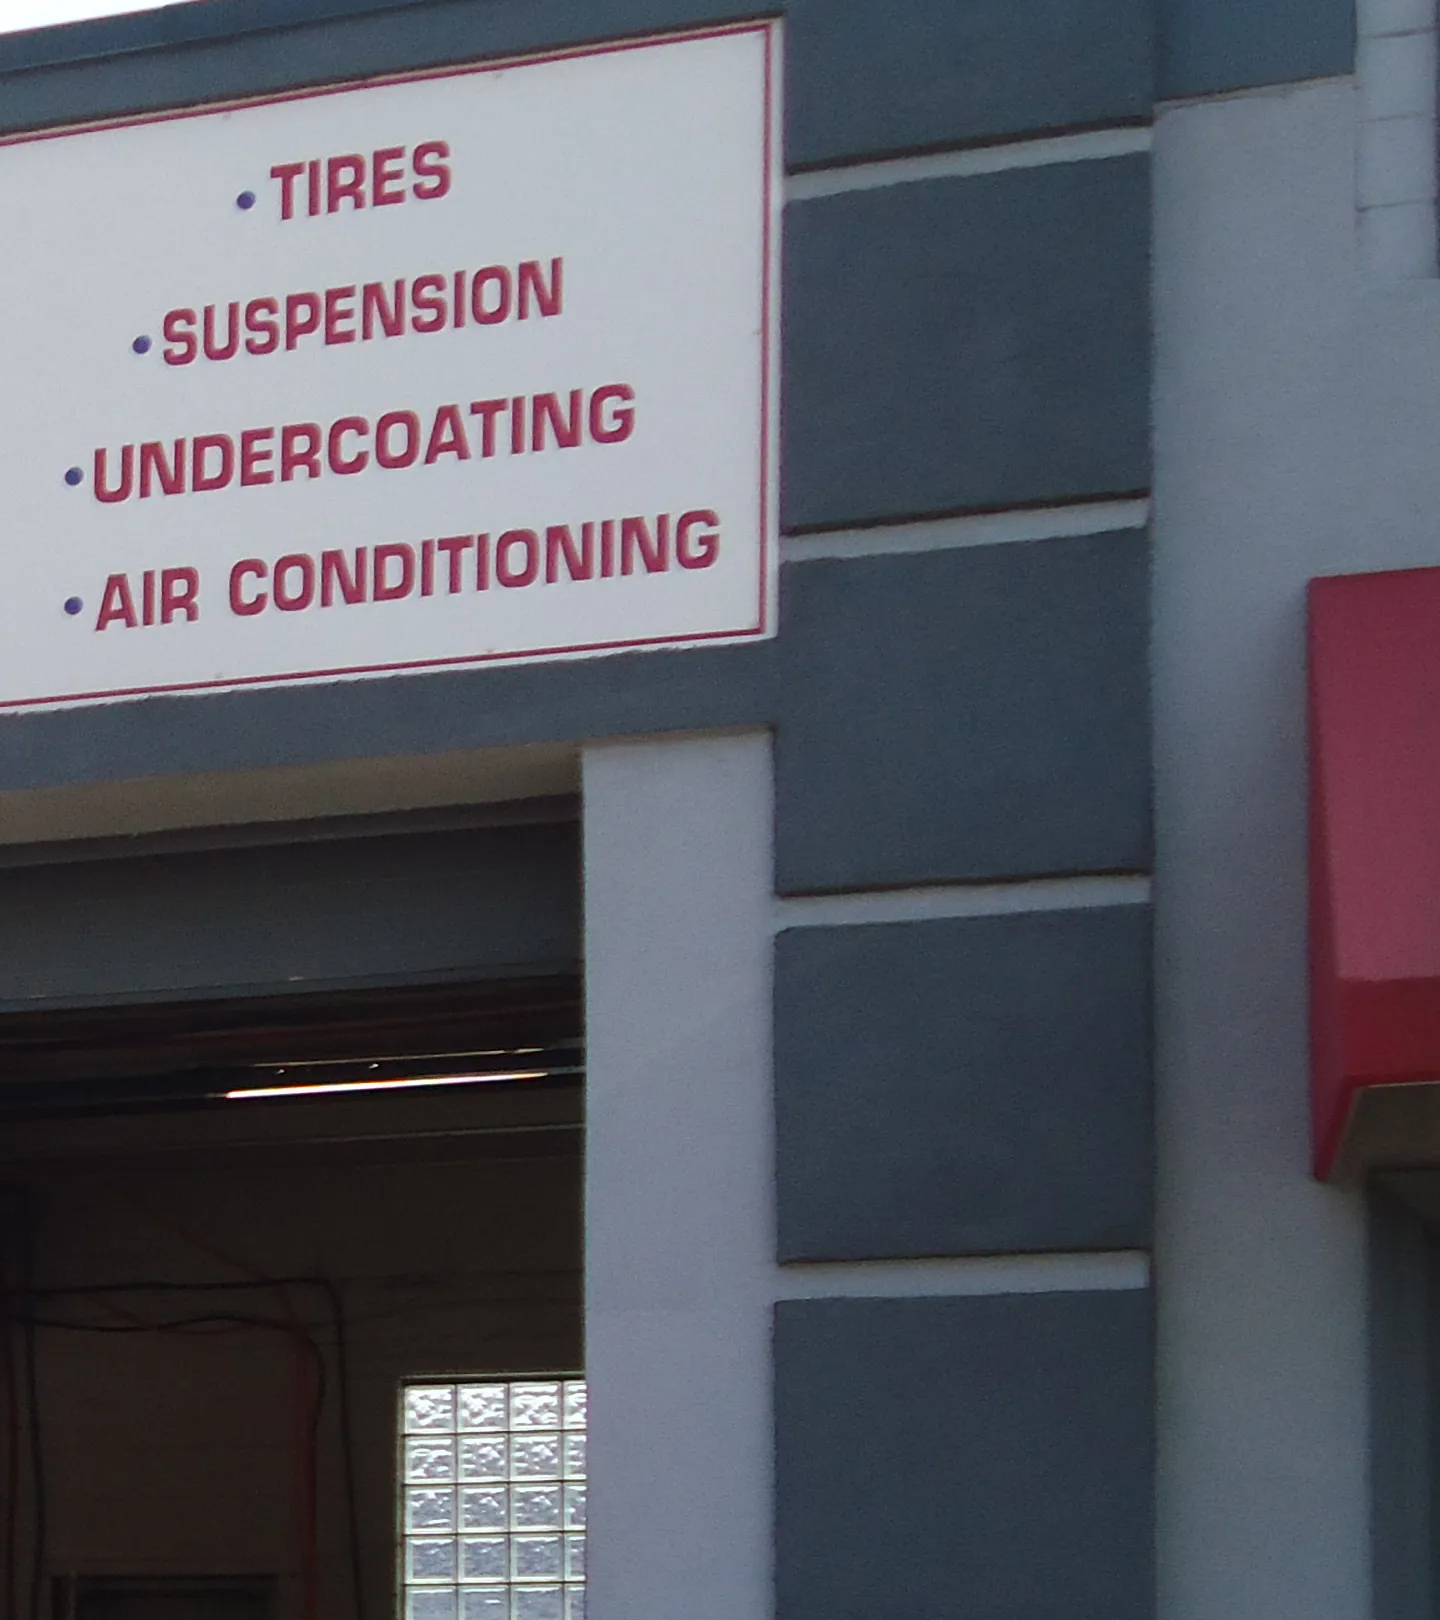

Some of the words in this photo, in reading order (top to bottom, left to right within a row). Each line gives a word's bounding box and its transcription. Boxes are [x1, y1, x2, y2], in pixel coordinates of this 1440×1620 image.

[269, 139, 453, 221] TIRES
[162, 256, 565, 367] SUSPENSION
[93, 382, 636, 505] UNDERCOATING
[94, 565, 200, 633] AIR
[228, 508, 721, 617] CONDITIONING
